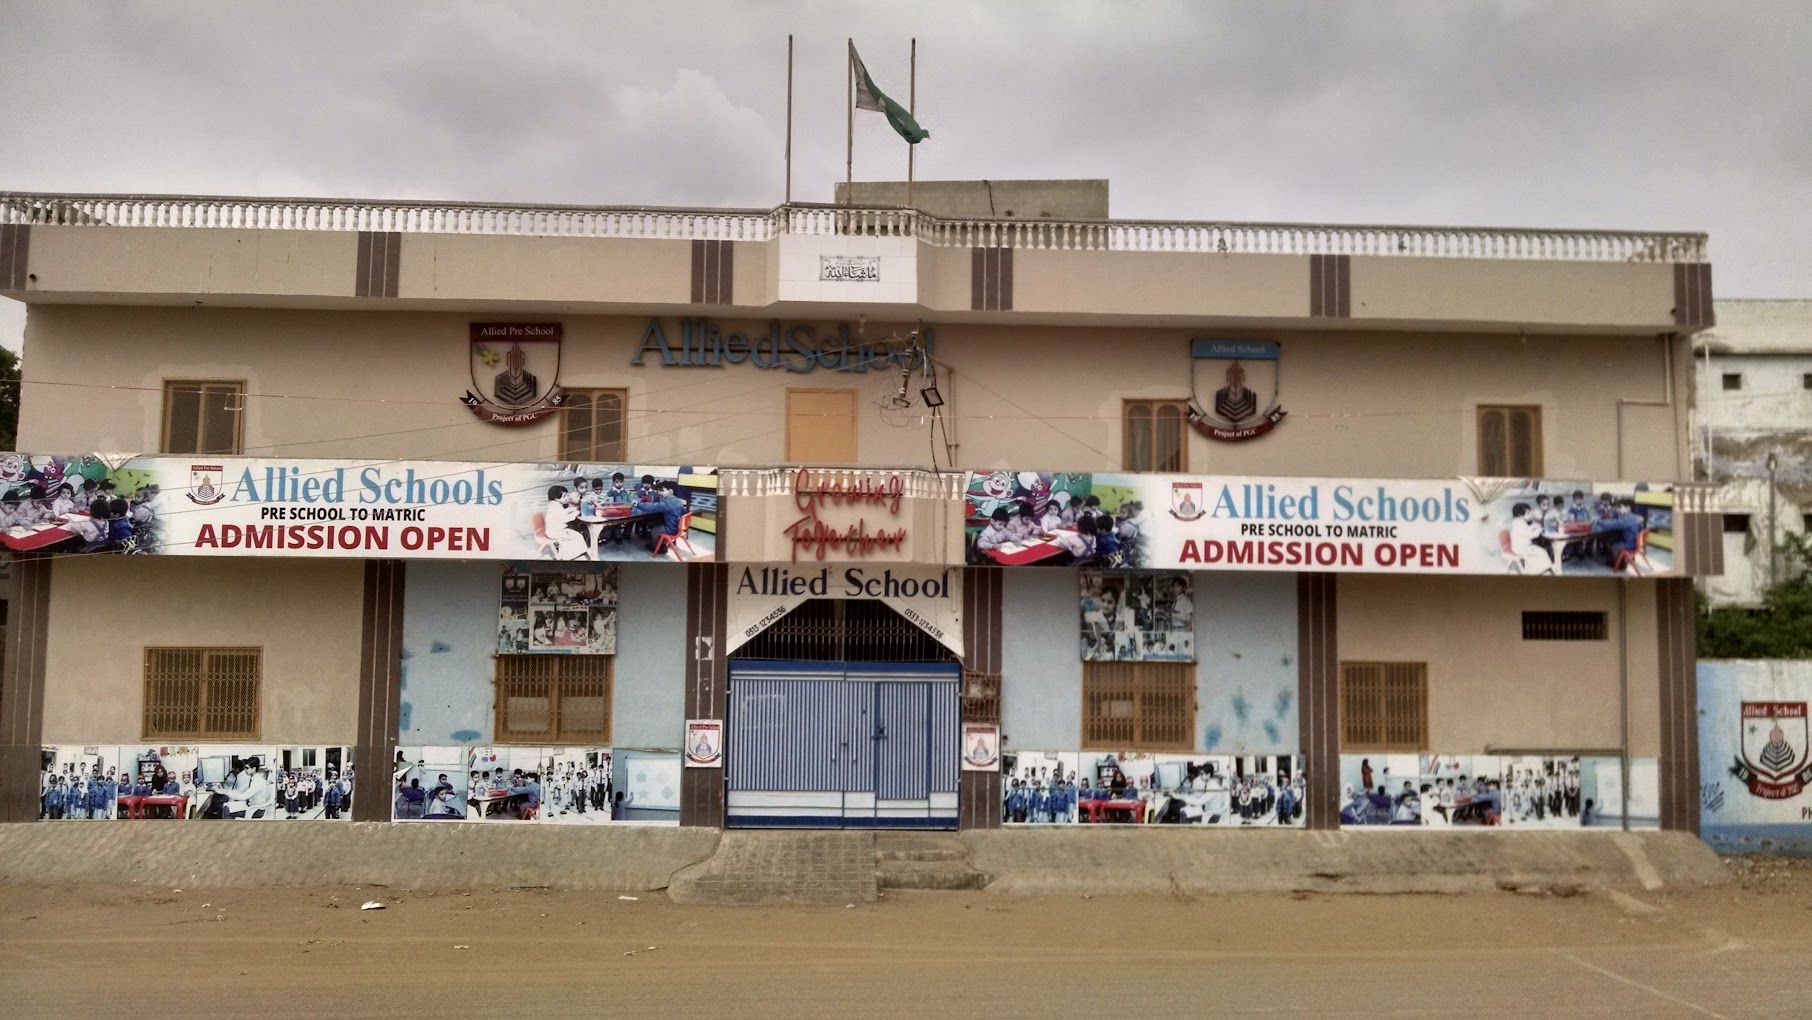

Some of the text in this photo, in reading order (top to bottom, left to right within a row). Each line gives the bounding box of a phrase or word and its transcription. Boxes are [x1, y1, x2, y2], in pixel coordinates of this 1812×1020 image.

[481, 326, 554, 336] Allied Pre School
[1210, 343, 1265, 354] Allied School
[492, 413, 514, 423] Project
[515, 414, 522, 422] of
[1214, 429, 1235, 438] Project
[1236, 430, 1242, 438] of
[230, 466, 503, 506] Allied Schools
[793, 468, 904, 521] Growing
[261, 507, 426, 522] PRE SCHOOL TO MATRIC
[1211, 484, 1470, 523] Allied Schools
[194, 523, 490, 552] ADMISSION OPEN
[783, 515, 907, 565] Together
[1241, 523, 1398, 538] PRE SCHOOL TO MATRIC
[1179, 539, 1459, 568] ADMISSION OPEN
[736, 566, 950, 599] Allied School
[1743, 703, 1802, 718] Allied School
